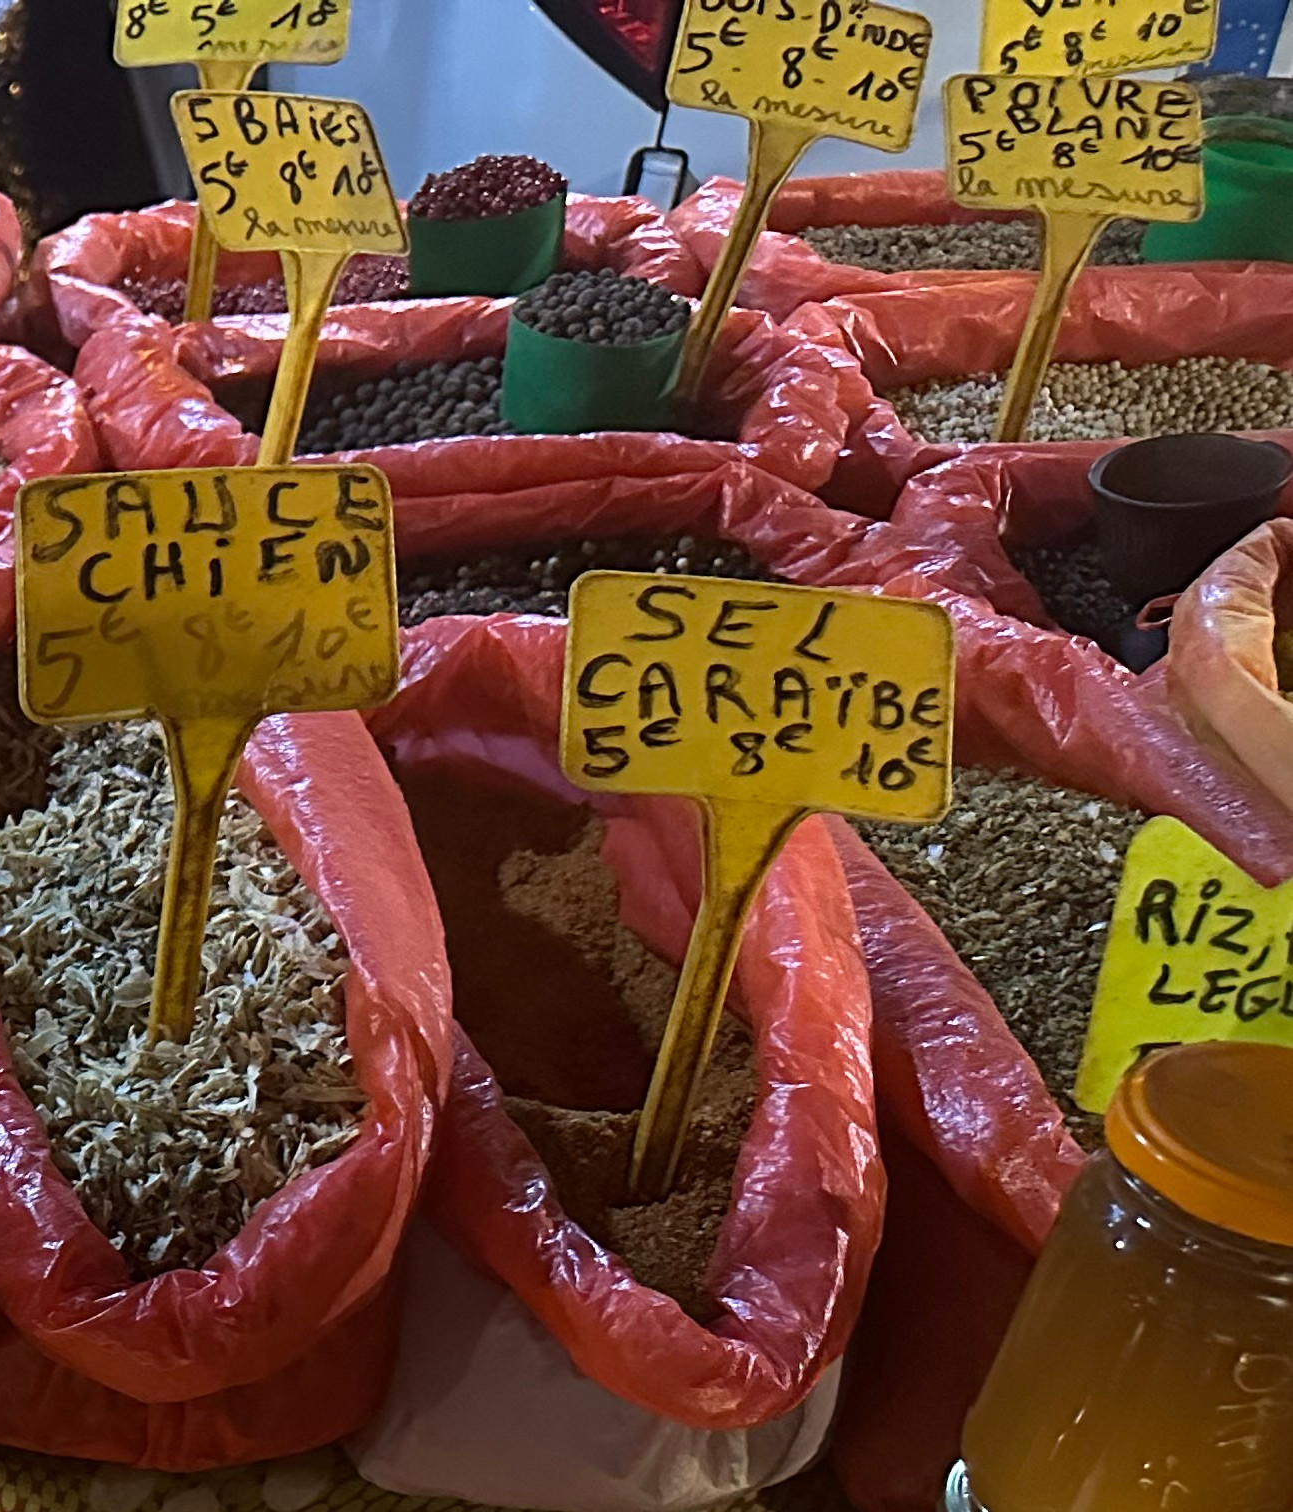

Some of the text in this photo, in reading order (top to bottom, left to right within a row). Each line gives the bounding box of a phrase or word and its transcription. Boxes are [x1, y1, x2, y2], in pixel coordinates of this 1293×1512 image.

[188, 97, 219, 143] 5
[1006, 105, 1186, 140] BLANC
[31, 472, 385, 563] SAUCE
[623, 584, 832, 663] SEL
